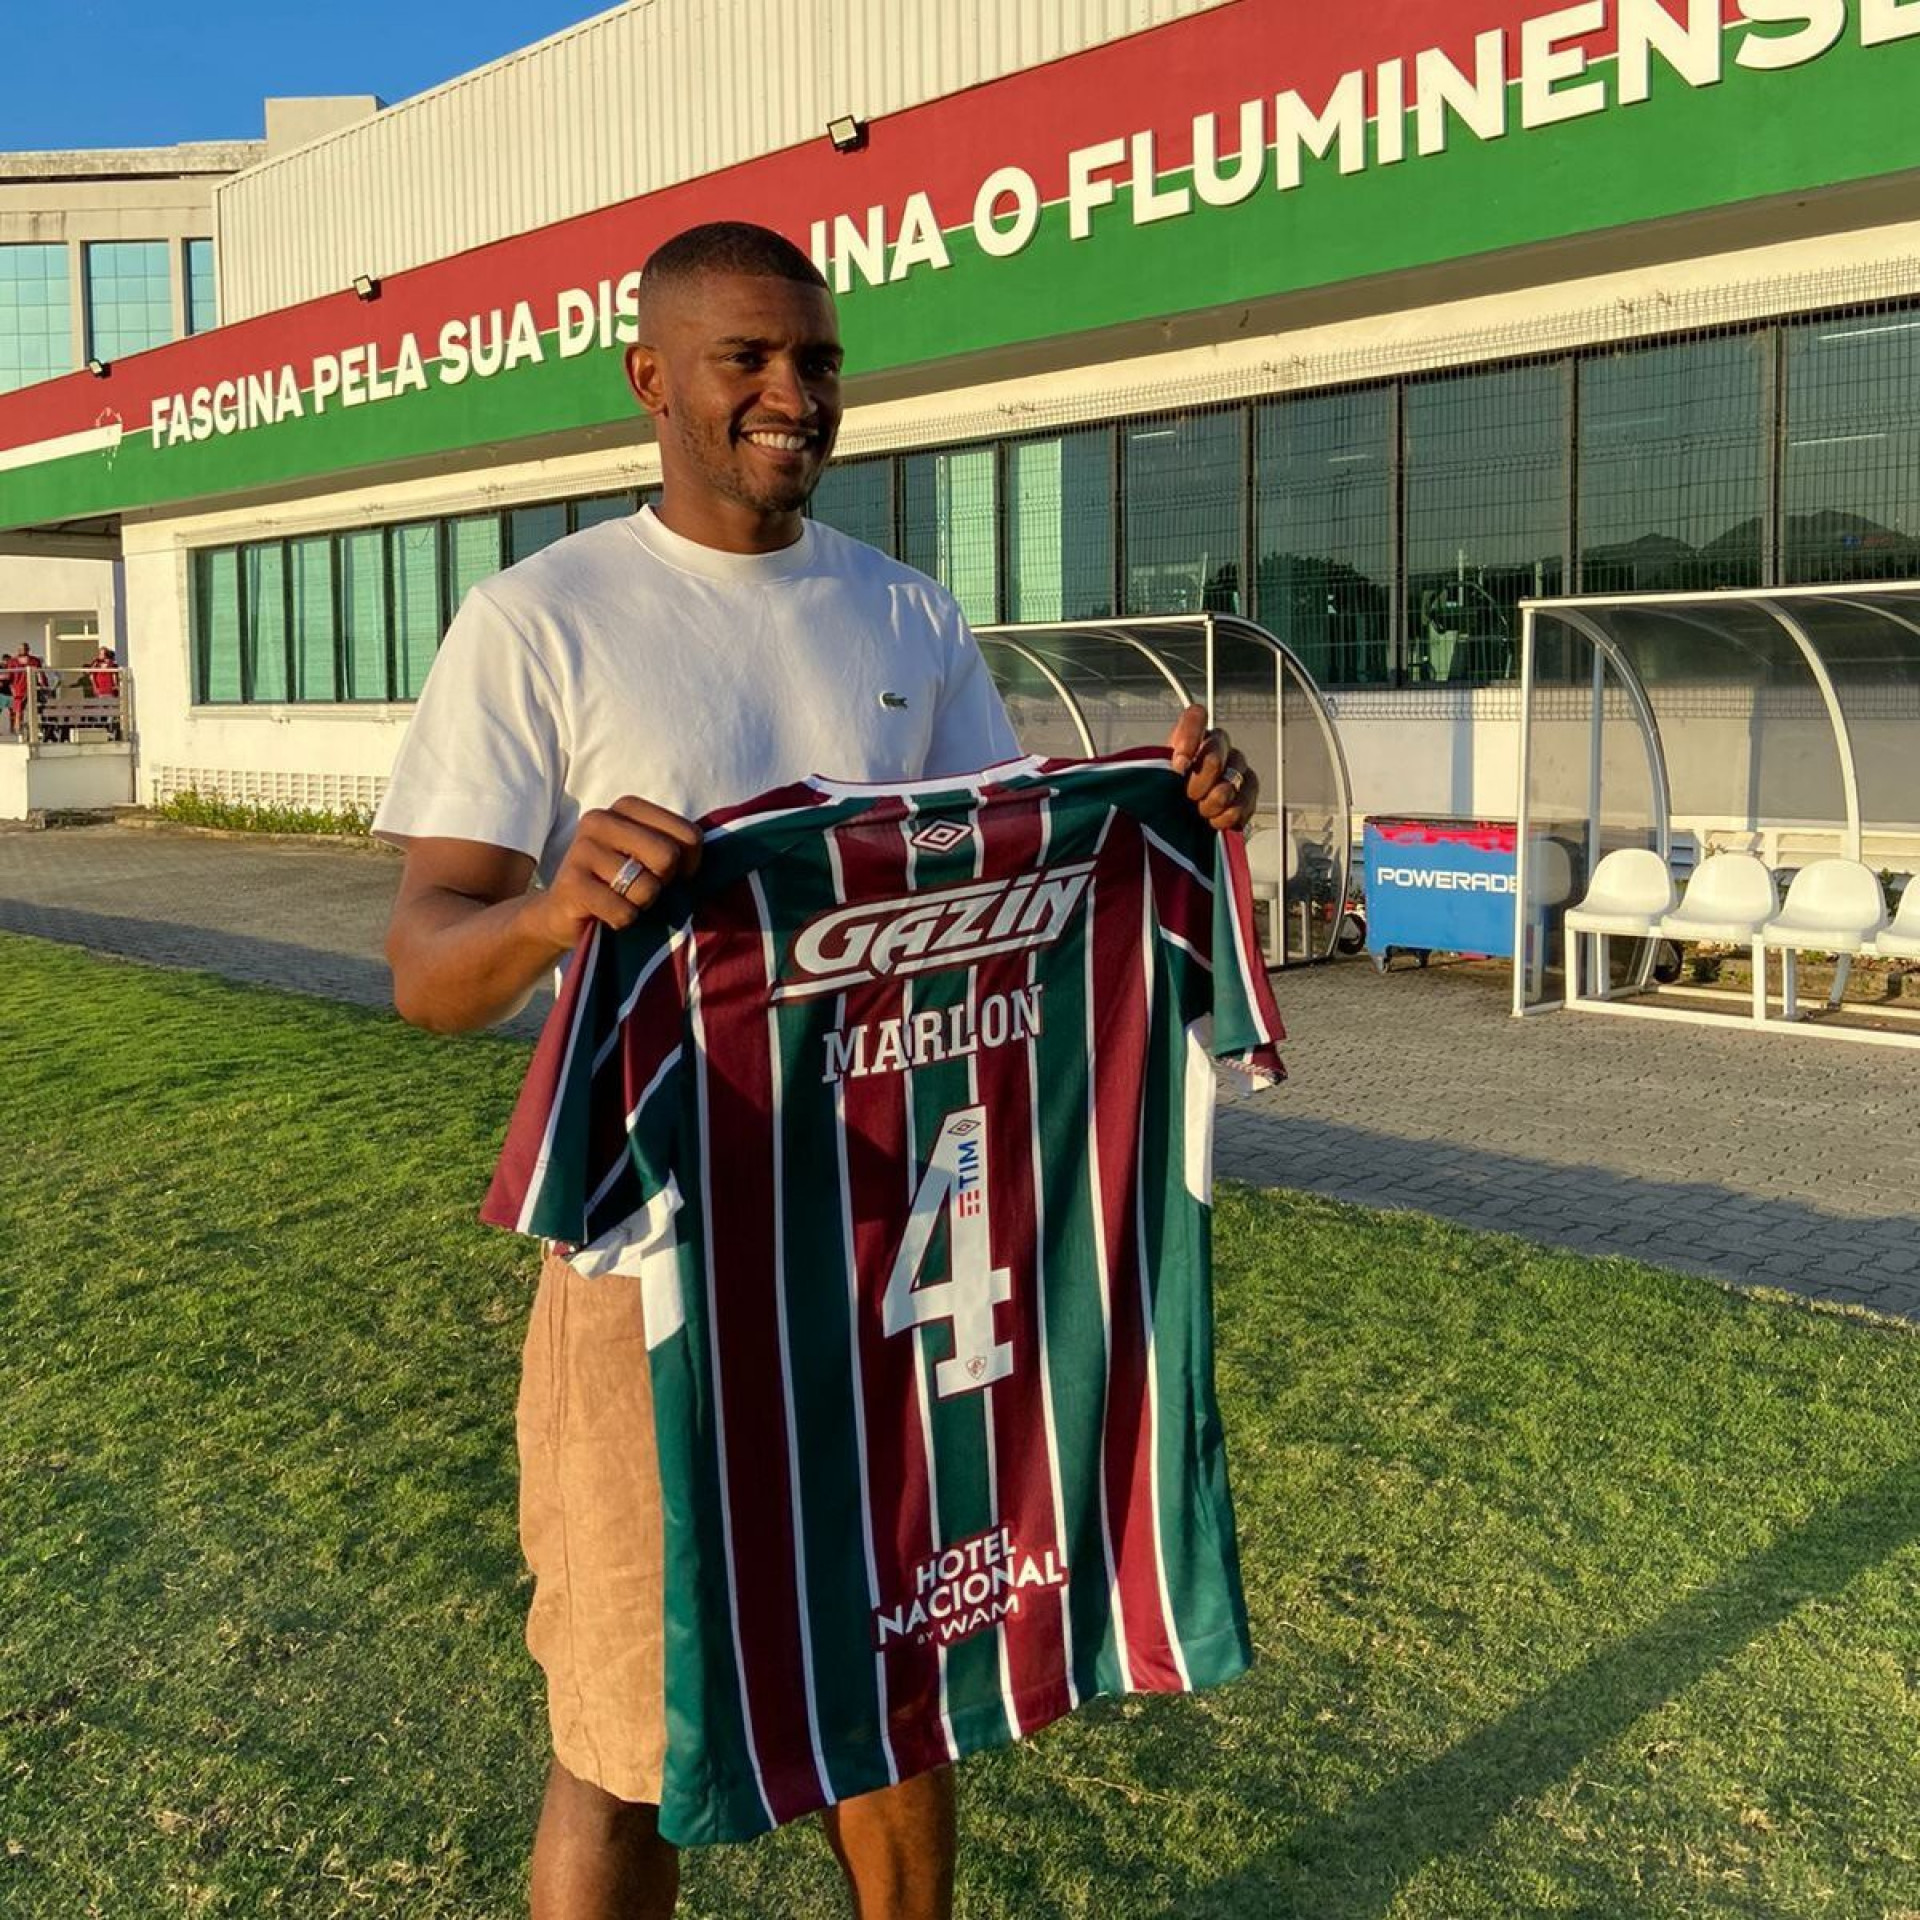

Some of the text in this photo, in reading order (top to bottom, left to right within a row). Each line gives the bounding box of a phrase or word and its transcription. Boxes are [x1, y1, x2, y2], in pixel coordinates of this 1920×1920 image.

[151, 364, 305, 449] FASCINA
[312, 332, 429, 414] PELA
[439, 300, 545, 384] SUA
[973, 165, 1039, 257] O
[788, 860, 1097, 978] GAZIN
[821, 984, 1044, 1084] MARLON
[958, 1139, 979, 1190] TIM
[882, 1105, 1014, 1398] 4
[877, 1551, 1064, 1646] NACIONAL
[916, 1527, 1017, 1596] HOTEL
[940, 1594, 1020, 1640] WAM
